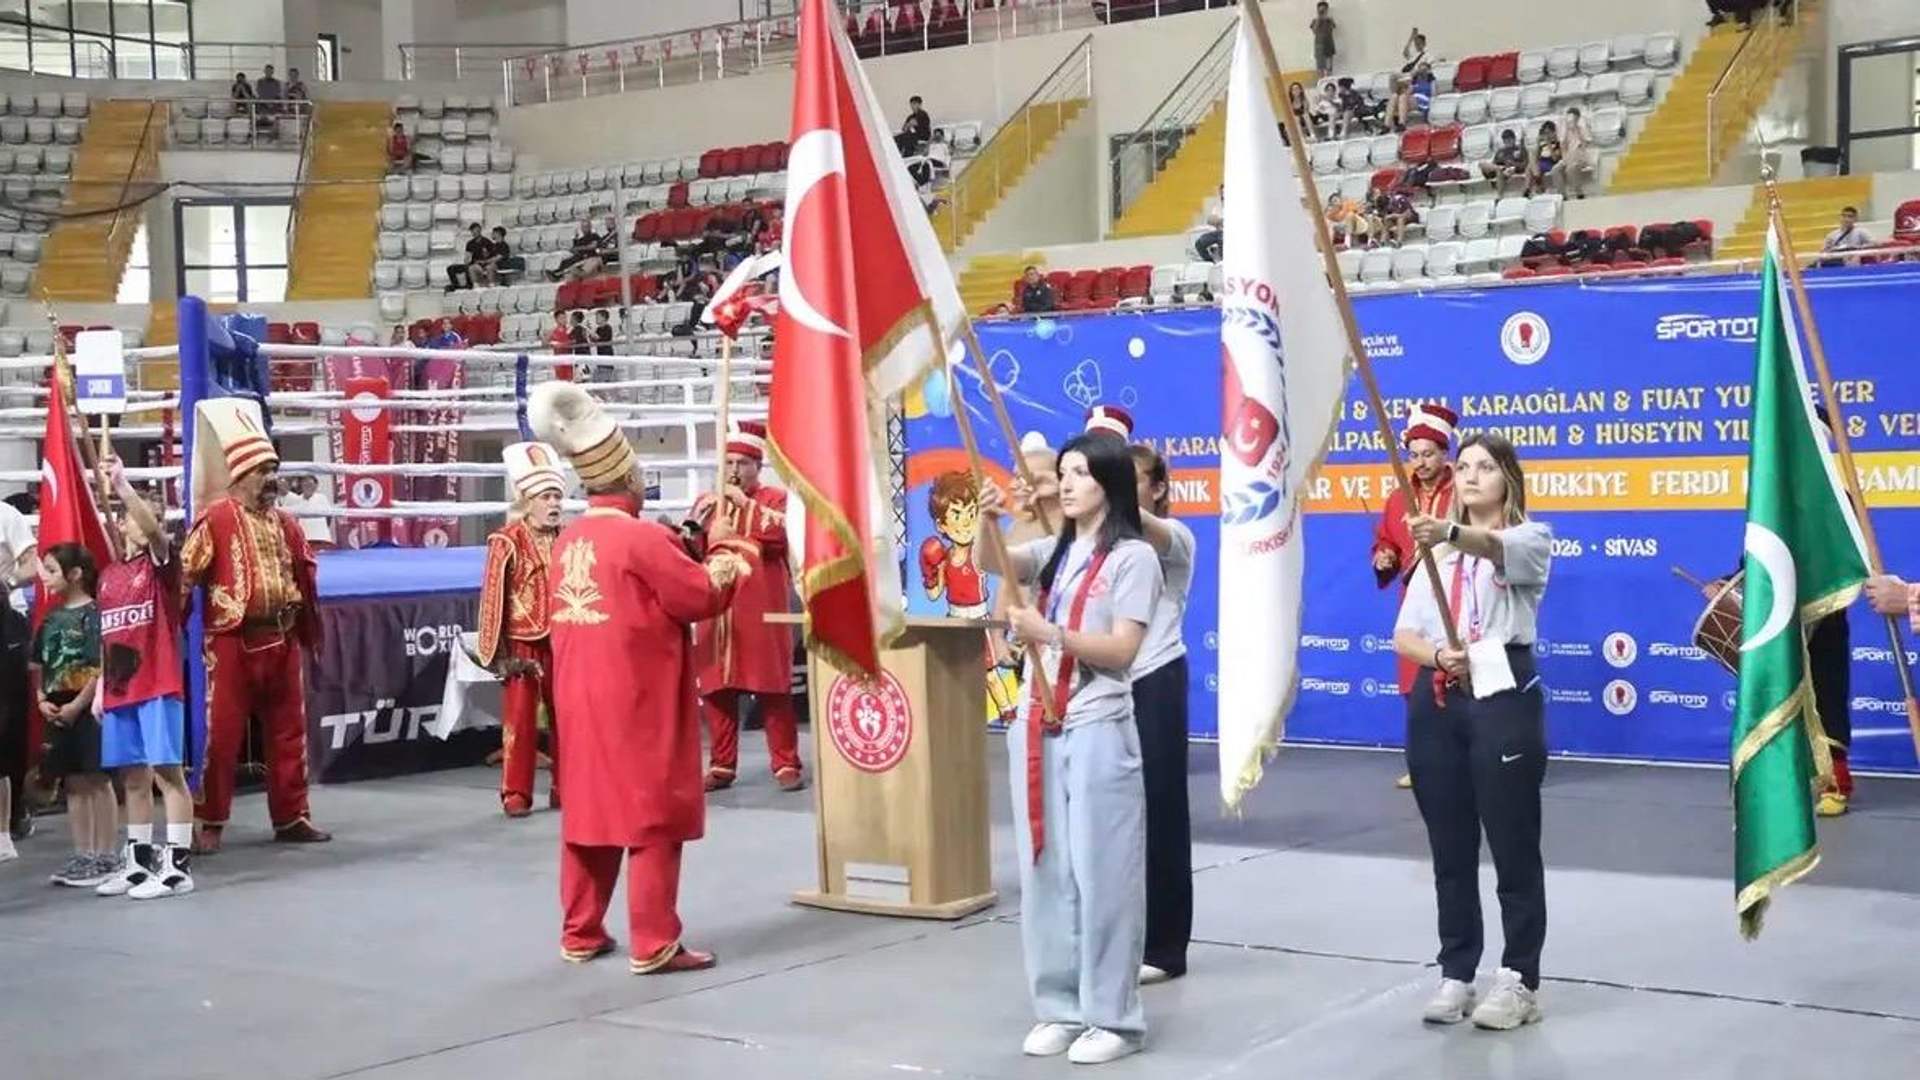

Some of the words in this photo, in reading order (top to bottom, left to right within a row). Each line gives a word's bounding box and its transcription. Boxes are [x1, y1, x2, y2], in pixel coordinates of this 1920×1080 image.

[1461, 387, 1605, 417] KARAOĞLAN
[1613, 390, 1631, 412] &
[1642, 387, 1704, 411] FUAT
[1567, 424, 1585, 446] &
[1596, 417, 1702, 445] HÜSEYİN
[1847, 414, 1867, 438] &
[1340, 474, 1372, 499] VE
[1649, 464, 1729, 496] FERDİ
[1604, 534, 1657, 557] SİVAS
[320, 698, 443, 749] TÜR
